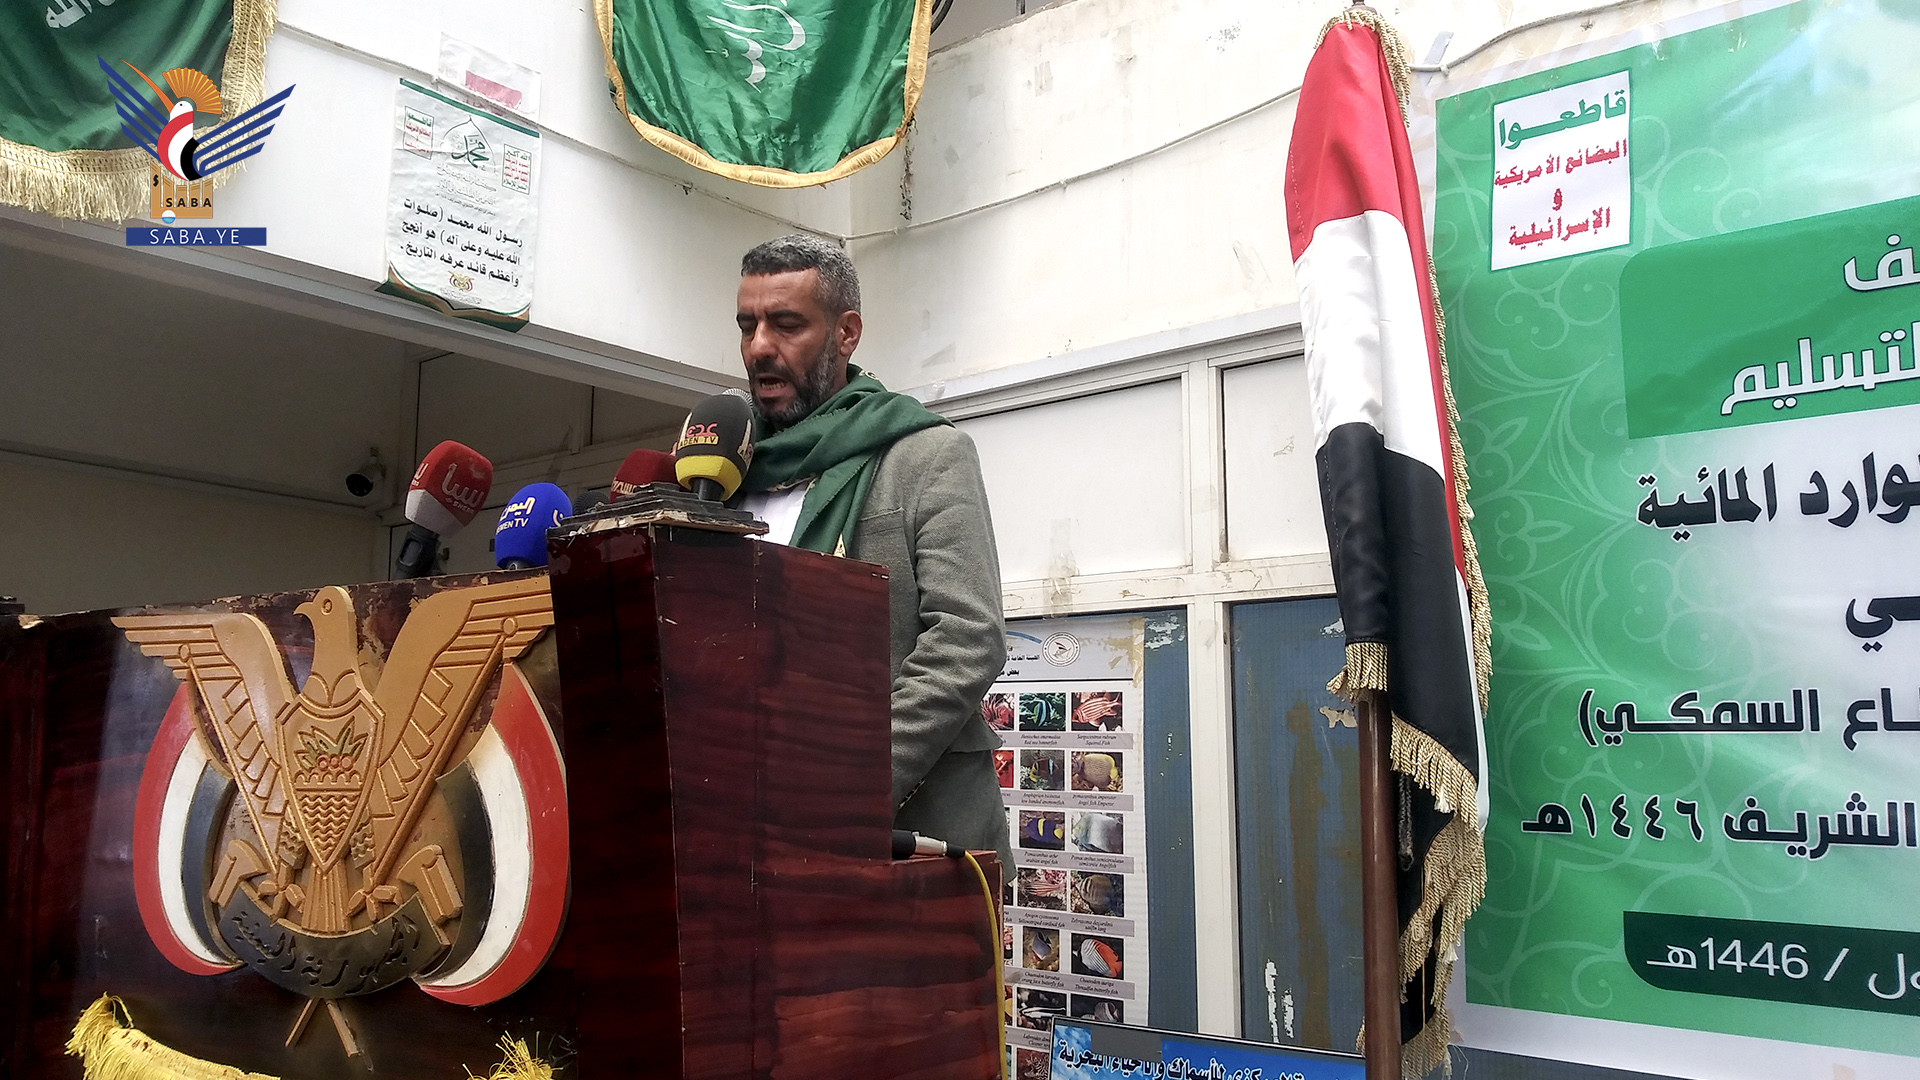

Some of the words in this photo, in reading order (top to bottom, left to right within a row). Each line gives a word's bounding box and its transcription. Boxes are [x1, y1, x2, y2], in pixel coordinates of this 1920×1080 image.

[1498, 89, 1627, 150] قاطعوا
[1565, 138, 1627, 174] البضائع
[1551, 187, 1564, 212] و
[446, 213, 475, 230] محمد
[477, 221, 492, 236] الله
[1508, 206, 1611, 250] الإسرائيلية
[424, 228, 437, 241] هو
[494, 229, 523, 248] رسول
[460, 240, 483, 257] وعلى
[483, 246, 505, 262] عليه
[466, 261, 487, 276] قائد
[506, 254, 520, 266] الله
[1720, 319, 1920, 416] لتسليم
[704, 435, 717, 444] TV
[1798, 450, 1920, 529] وارد
[1636, 461, 1778, 542] المائية
[514, 517, 529, 528] TV
[1722, 791, 1918, 861] الشريف
